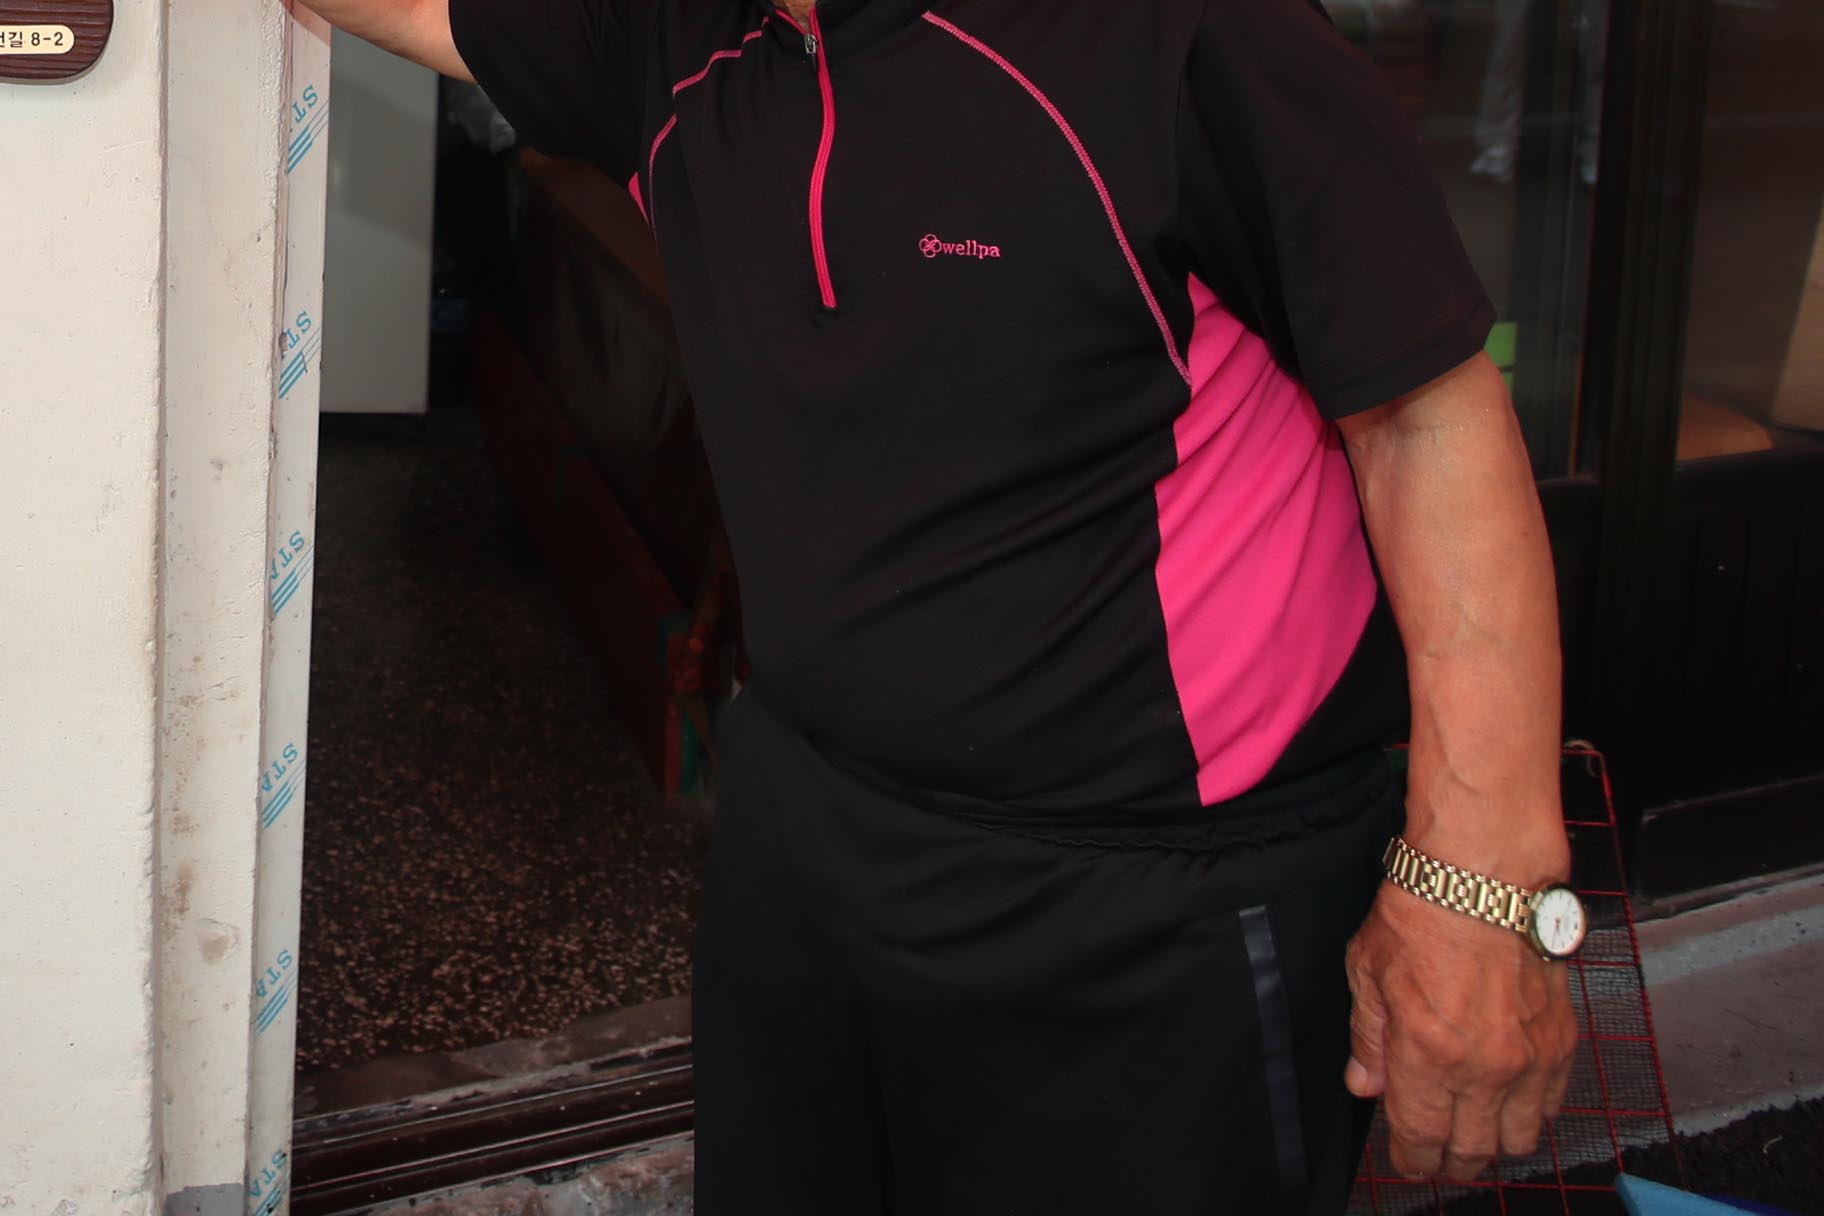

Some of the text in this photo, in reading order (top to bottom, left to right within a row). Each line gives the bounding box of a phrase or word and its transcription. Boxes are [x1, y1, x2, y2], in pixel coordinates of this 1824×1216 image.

[31, 30, 64, 48] 8-2
[289, 84, 319, 131] ST
[941, 239, 1001, 260] wellpa
